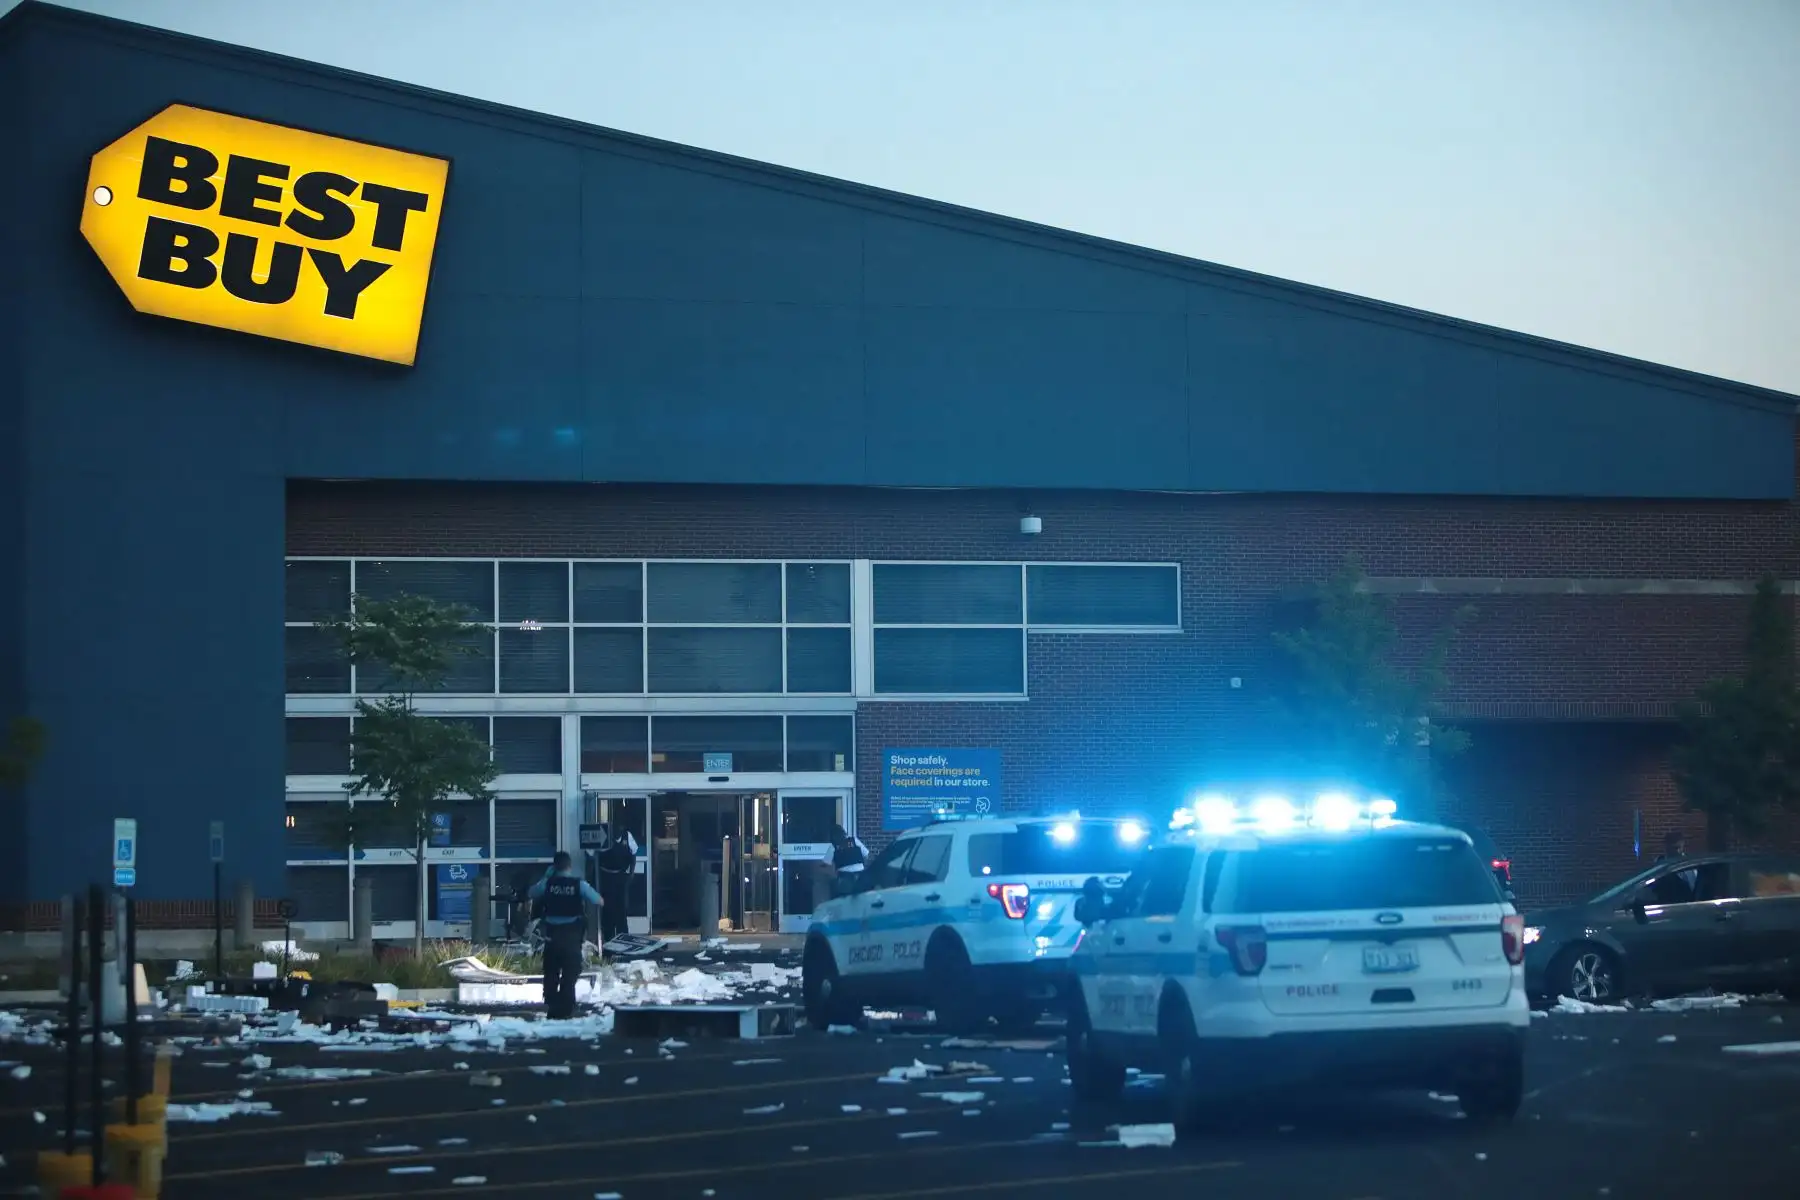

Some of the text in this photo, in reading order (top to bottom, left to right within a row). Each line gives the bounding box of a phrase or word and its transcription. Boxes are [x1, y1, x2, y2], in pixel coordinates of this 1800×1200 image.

[137, 135, 429, 252] BEST
[137, 215, 393, 320] BUY
[706, 759, 730, 767] ENTER
[890, 755, 949, 766] Shop safely.
[890, 766, 981, 777] Face coverings are
[890, 777, 991, 787] required in our store.
[550, 885, 575, 895] POLICE
[893, 940, 921, 959] POLICE
[1286, 983, 1339, 997] POLICE
